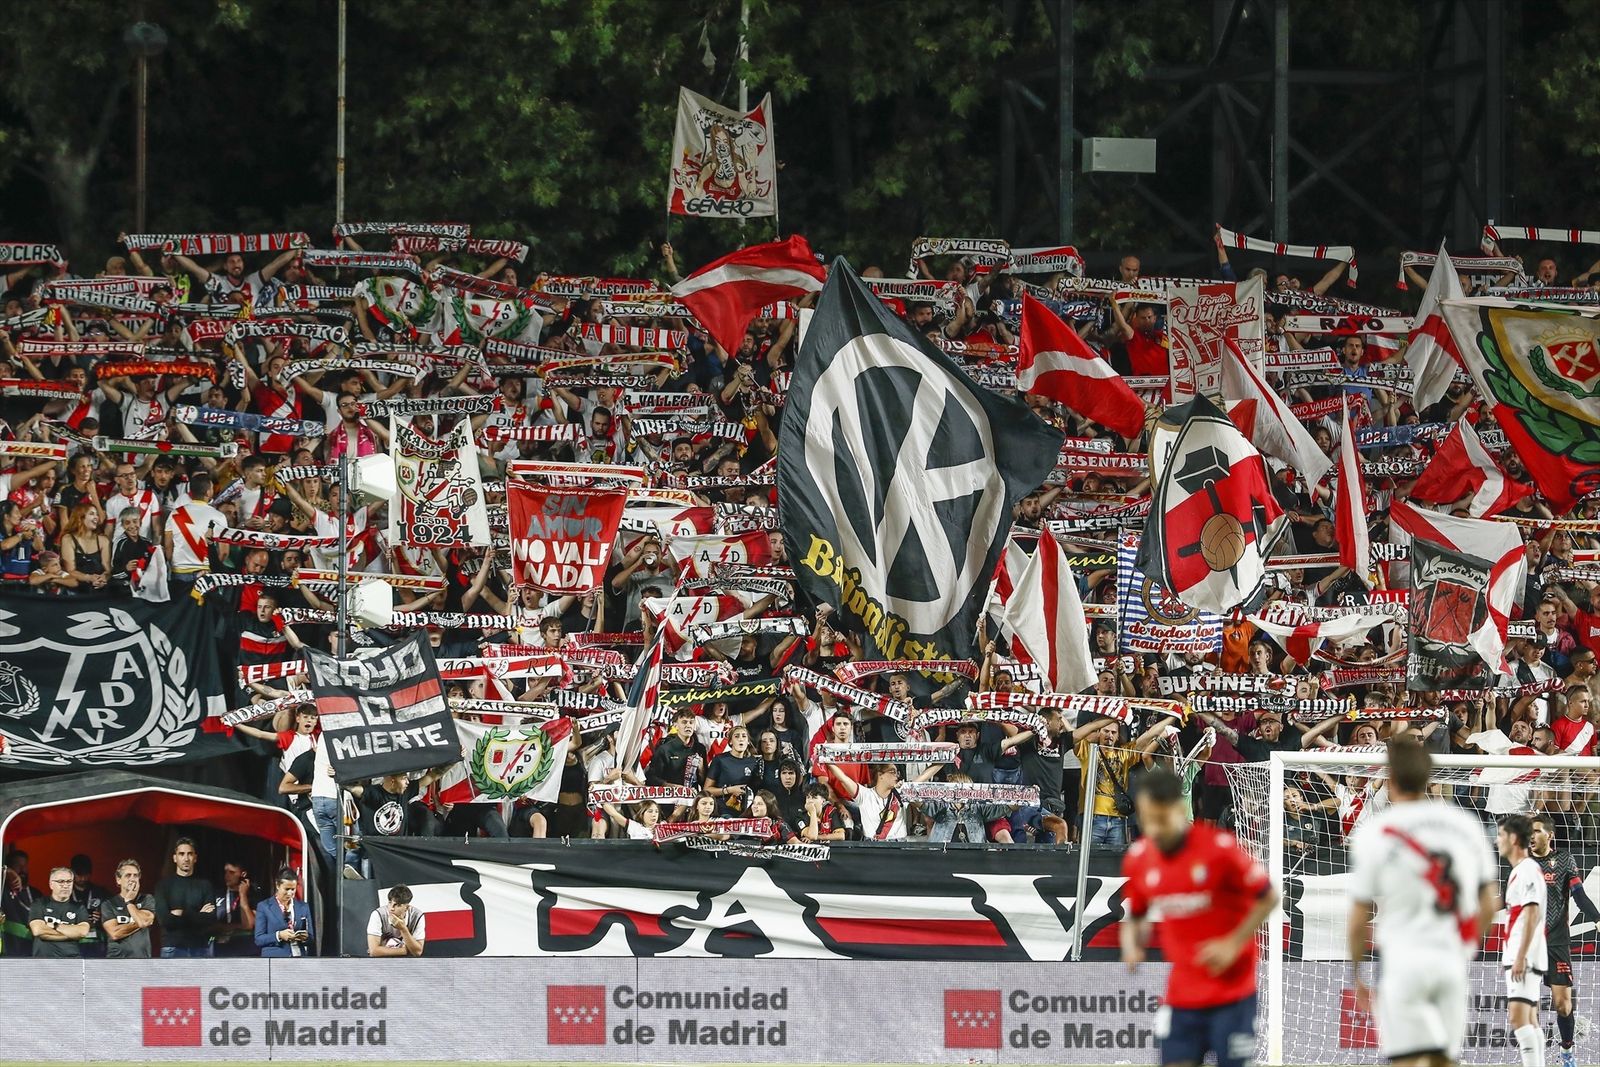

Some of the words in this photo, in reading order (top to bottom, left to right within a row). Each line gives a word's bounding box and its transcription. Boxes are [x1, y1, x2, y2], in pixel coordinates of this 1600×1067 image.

[1014, 254, 1067, 266] allecano
[876, 283, 936, 297] VALLECANO
[1320, 317, 1384, 331] RAYO
[1278, 351, 1332, 364] VALLECANO
[638, 393, 714, 408] VALLECANO
[1311, 394, 1355, 411] VALLECAO
[542, 495, 588, 516] SIN
[415, 516, 448, 525] DESDE
[219, 527, 259, 545] LOS
[397, 521, 473, 545] 1924
[513, 538, 546, 562] NO
[524, 562, 594, 589] NADA
[1130, 622, 1147, 634] de
[1150, 623, 1192, 639] todos
[1197, 623, 1215, 637] los
[1130, 637, 1215, 653] naufragios
[248, 663, 276, 683] EL
[311, 640, 427, 691] RAYO
[332, 722, 449, 760] MUERTE
[208, 985, 387, 1010] Comunidad
[612, 984, 788, 1010] Comunidad
[209, 1020, 251, 1046] de
[266, 1019, 387, 1046] Madrid
[613, 1019, 655, 1046] de
[668, 1019, 787, 1046] Madrid
[1009, 1023, 1051, 1049] de
